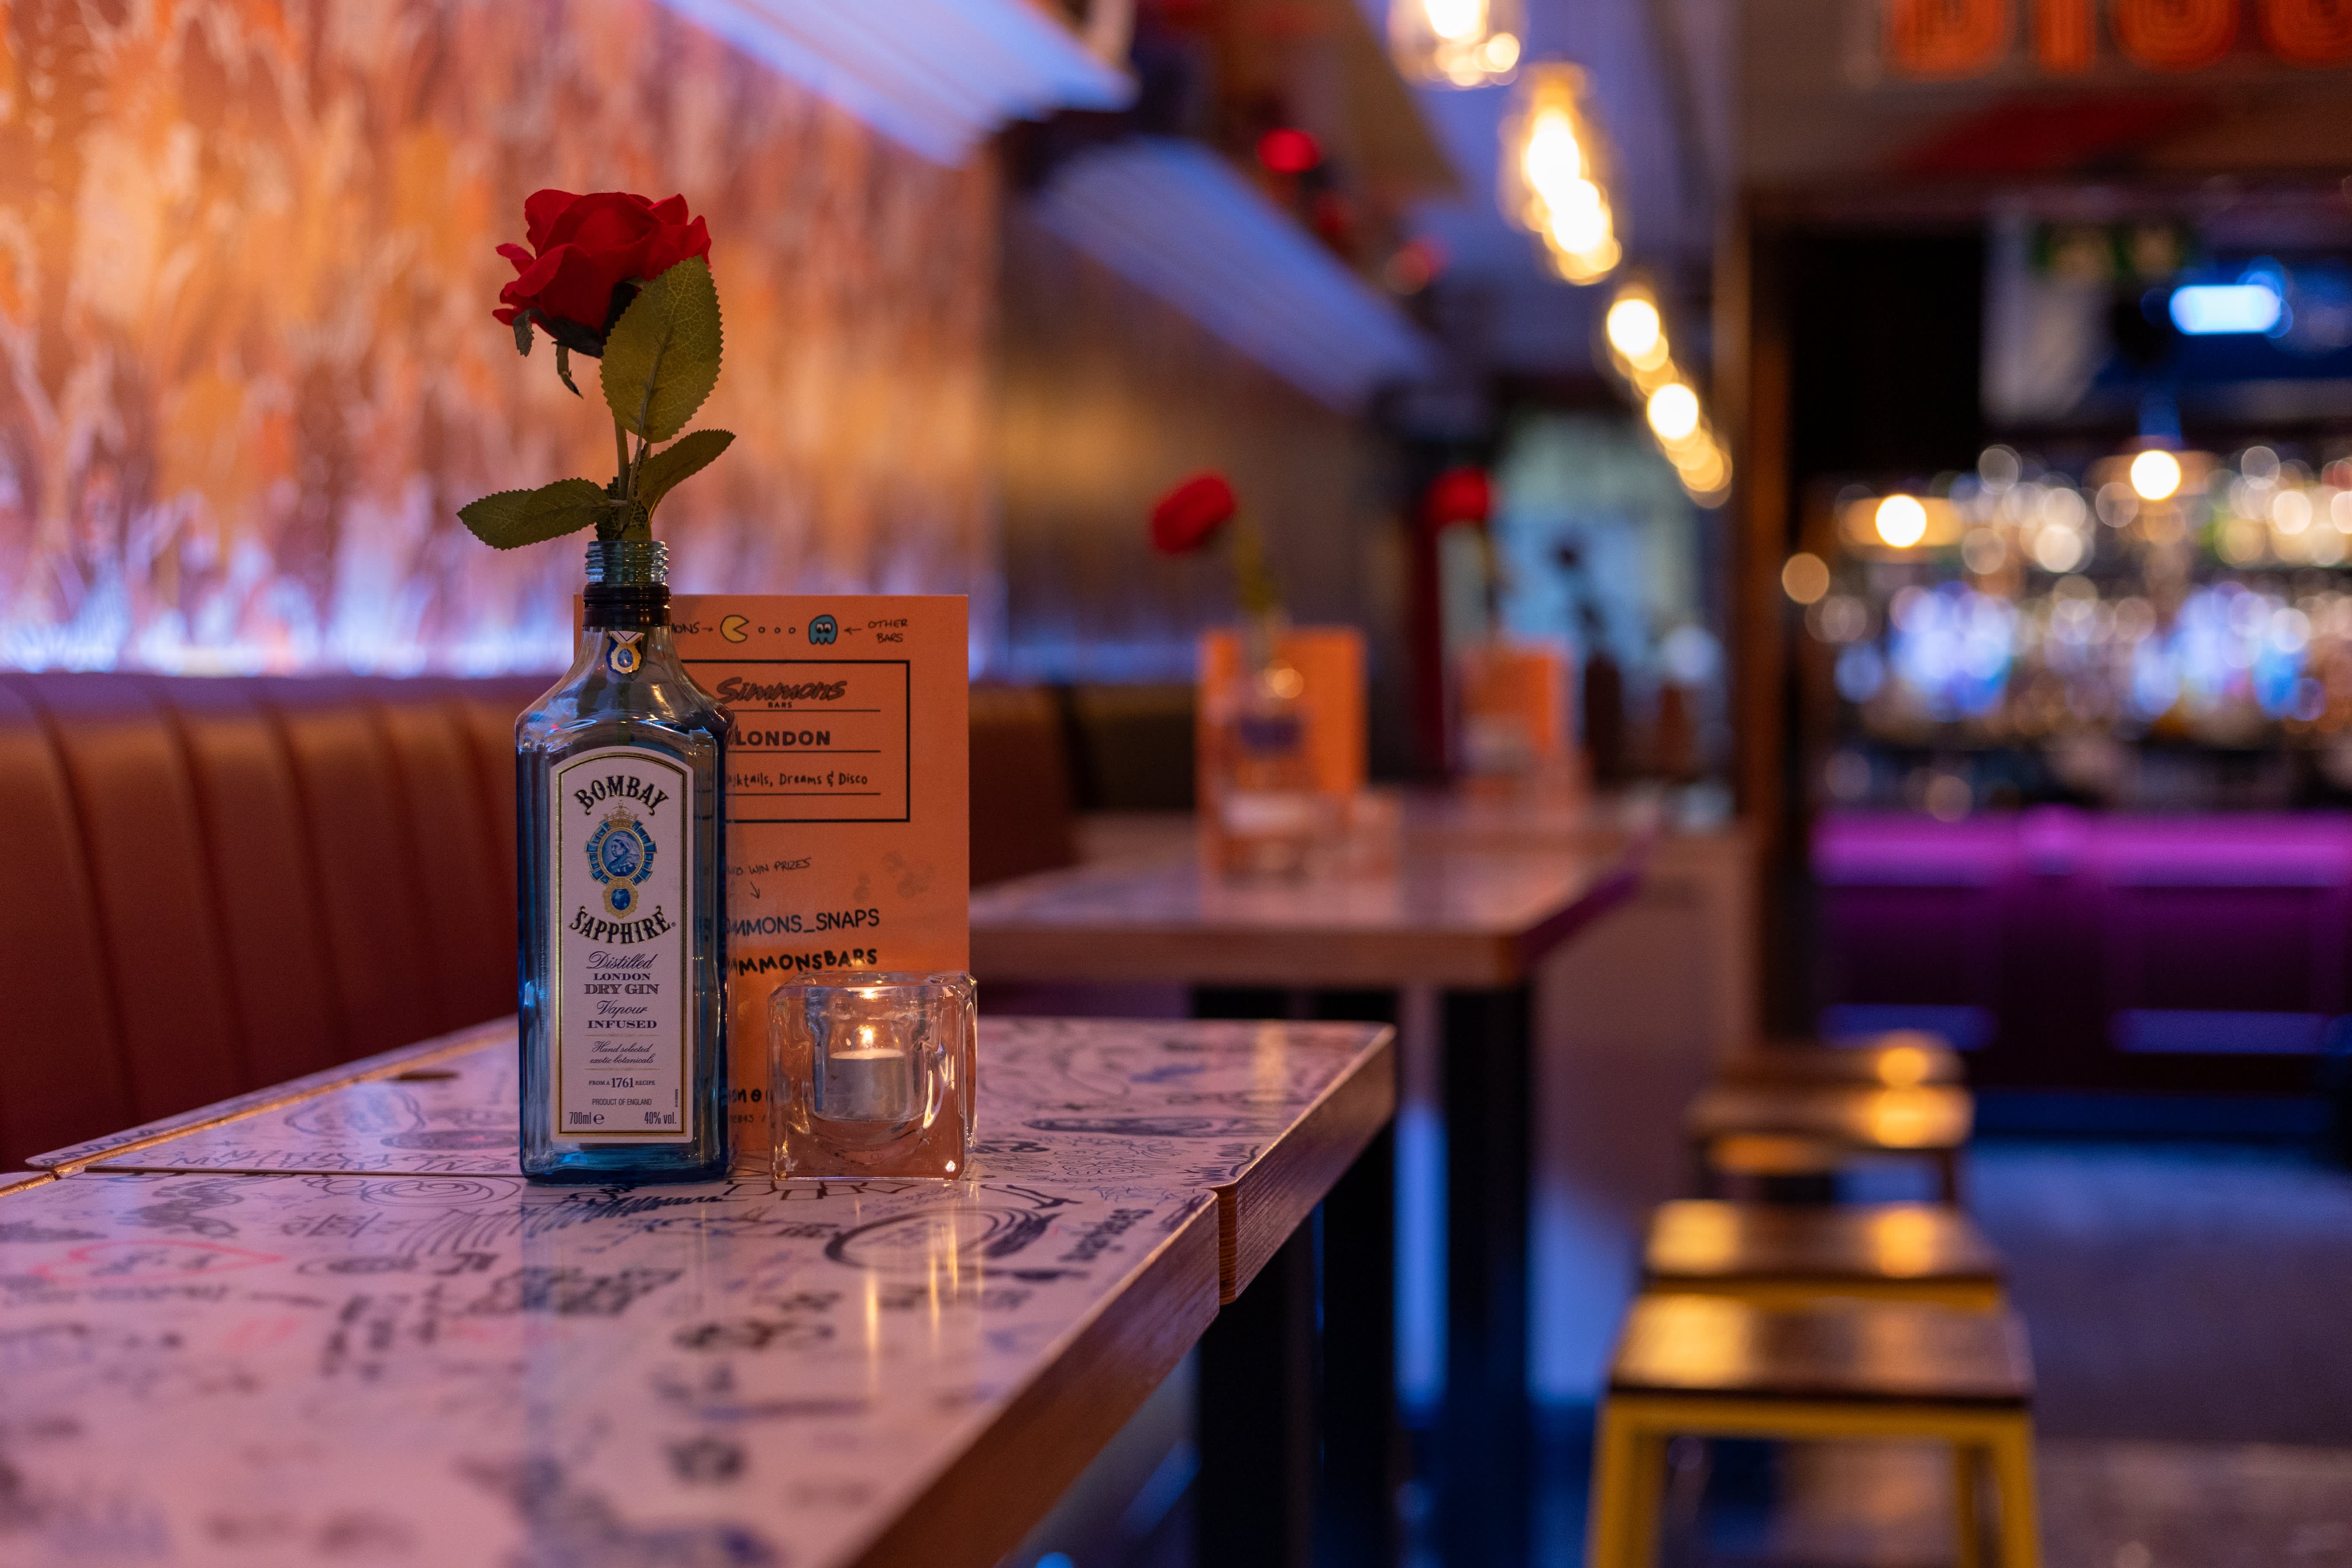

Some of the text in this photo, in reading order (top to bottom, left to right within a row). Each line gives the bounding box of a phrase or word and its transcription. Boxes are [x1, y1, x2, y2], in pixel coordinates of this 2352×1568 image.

[868, 619, 908, 628] OTHER
[876, 633, 903, 643] BARS
[716, 676, 848, 704] Simmons
[736, 731, 830, 746] LONDON
[779, 773, 821, 785] Dreams
[839, 773, 868, 785] Disco
[574, 775, 669, 816] BOMBAY
[749, 864, 769, 875] WIN
[774, 857, 812, 871] PRIZES
[569, 905, 671, 944] SAPPHIRE
[586, 951, 658, 969] Distilled
[584, 983, 660, 995] DRY GIN
[597, 1000, 648, 1019] Vapour
[588, 1020, 657, 1029] INFUSED
[592, 1041, 654, 1053] Hand selected
[613, 1053, 656, 1064] botanicals
[611, 1077, 634, 1088] 1761
[644, 1111, 662, 1124] 40%
[663, 1112, 677, 1124] vol.
